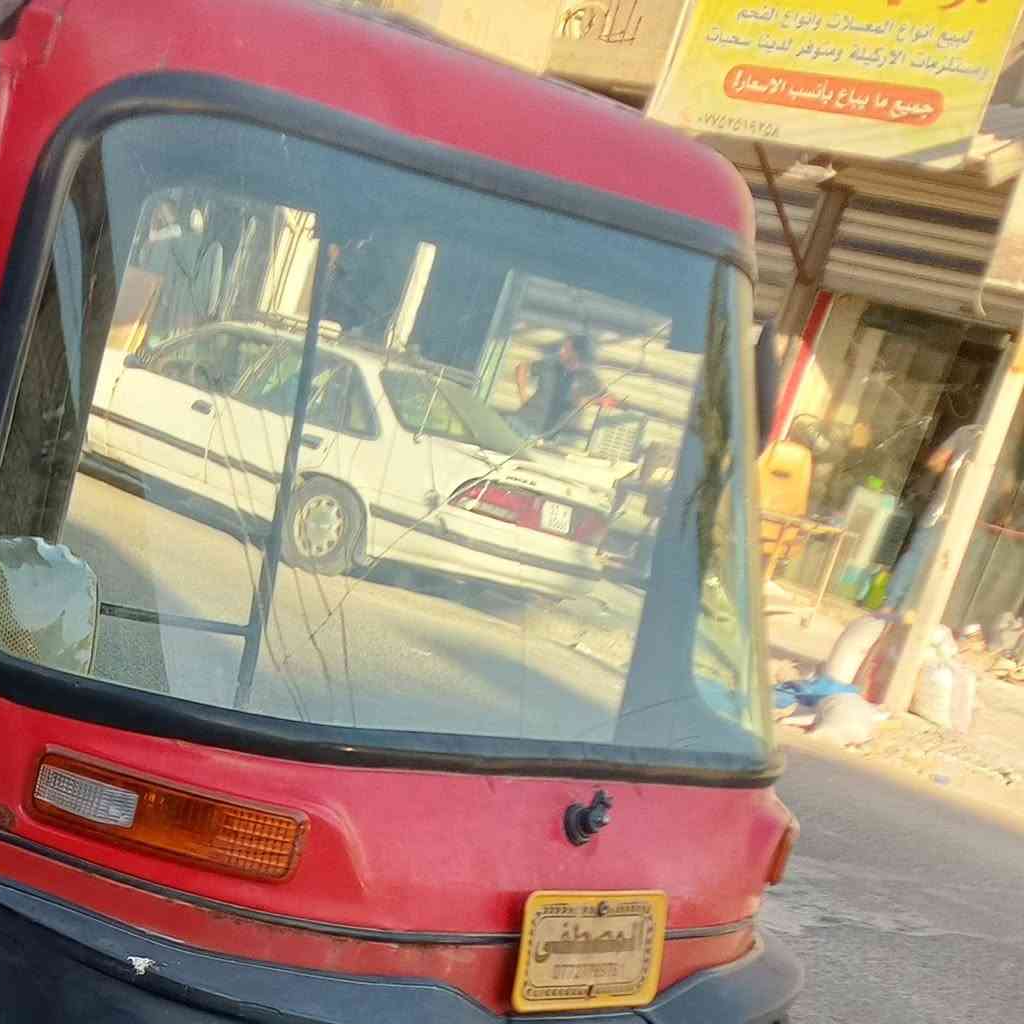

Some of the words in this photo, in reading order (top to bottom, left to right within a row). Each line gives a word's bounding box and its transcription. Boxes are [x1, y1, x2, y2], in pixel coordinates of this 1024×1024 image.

[835, 87, 869, 110] يباع
[876, 92, 888, 108] ما
[890, 99, 935, 119] جميع
